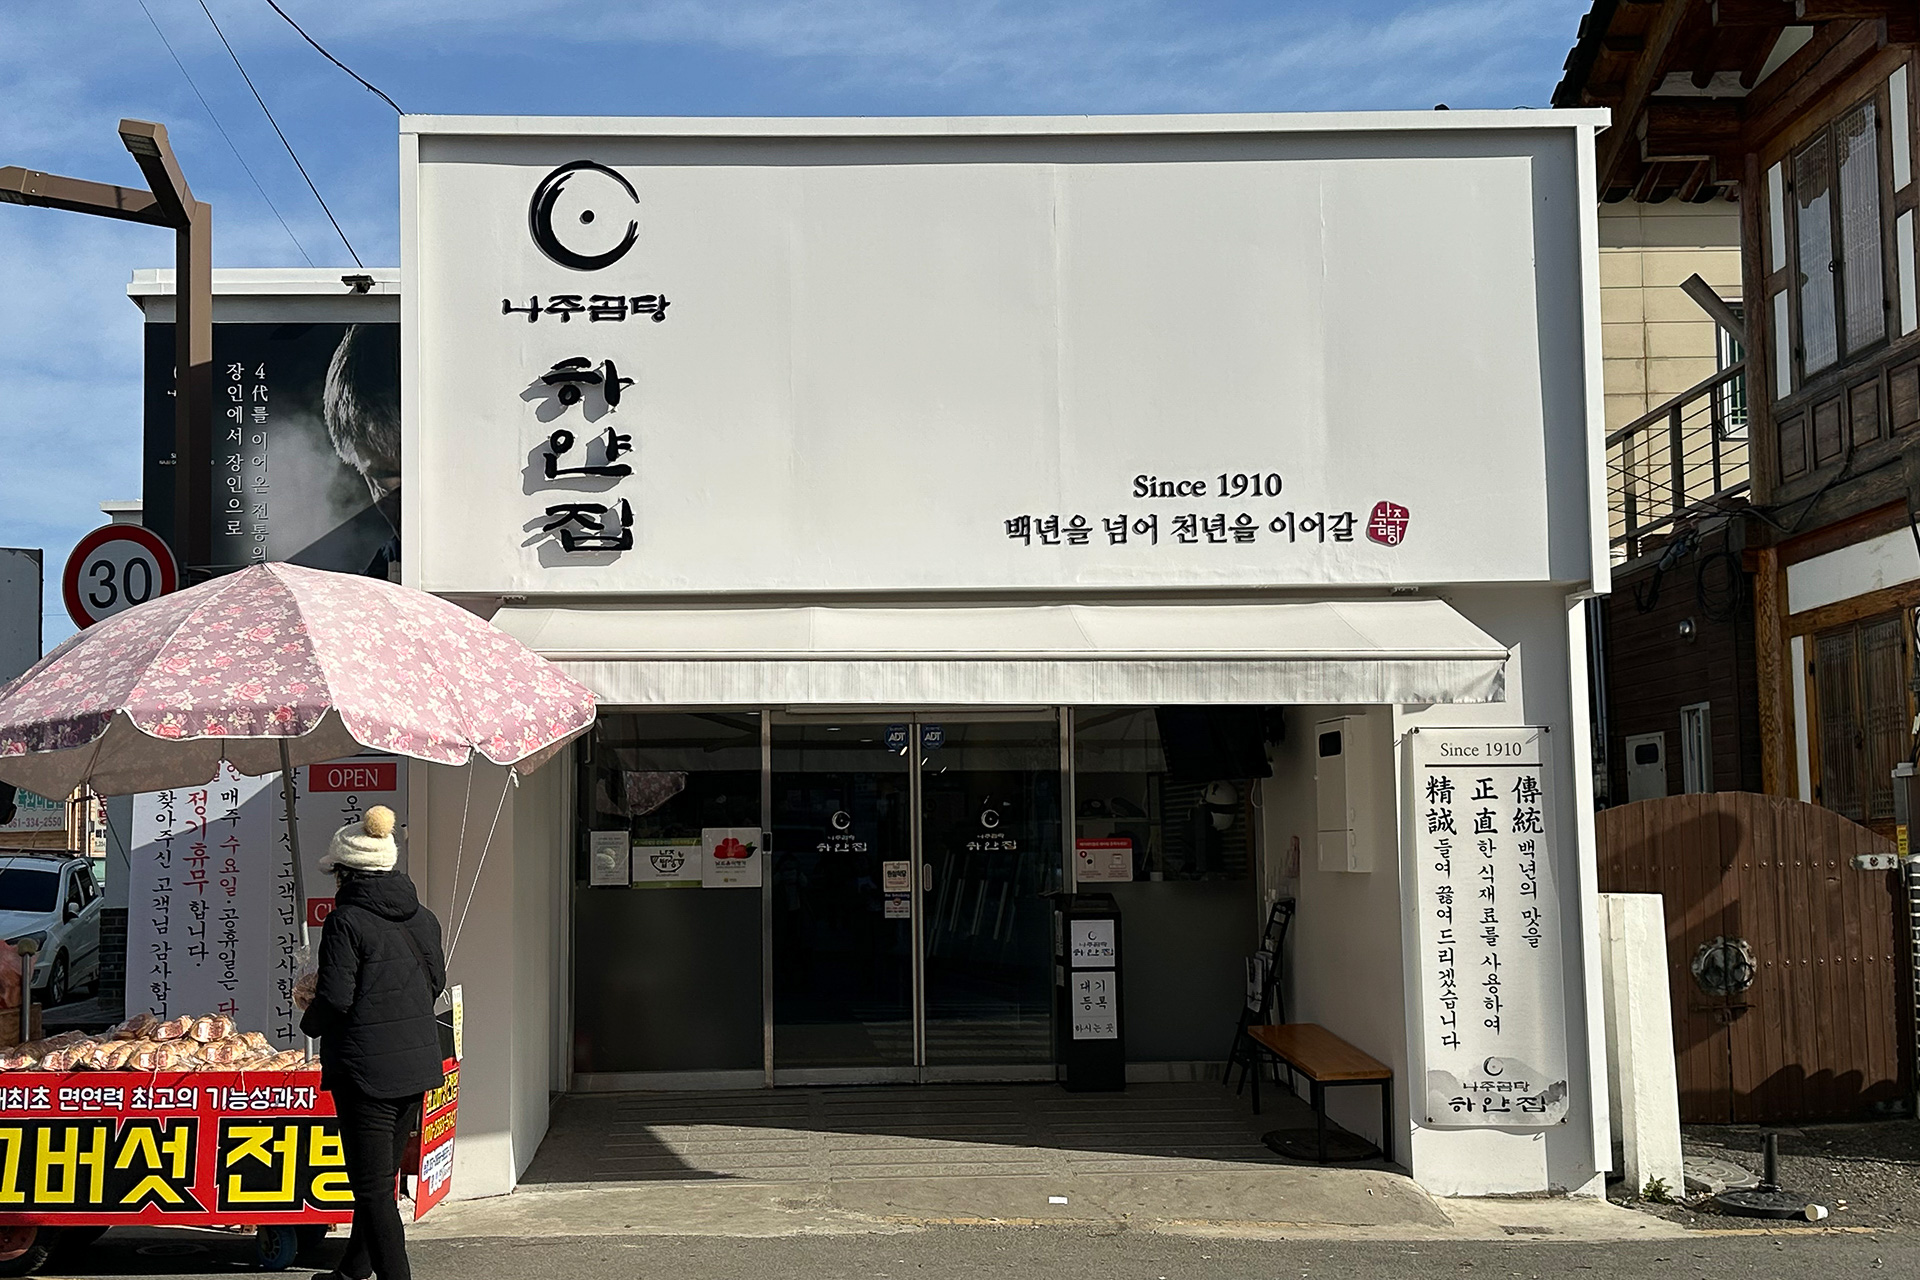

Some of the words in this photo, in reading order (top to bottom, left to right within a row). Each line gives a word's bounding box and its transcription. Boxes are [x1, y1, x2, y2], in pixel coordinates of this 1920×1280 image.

[501, 294, 671, 323] 나주곰탕
[226, 362, 245, 446] 장인에서
[251, 431, 270, 493] 이어온
[540, 356, 635, 552] 하얀집
[225, 454, 244, 536] 장인으로
[1132, 473, 1207, 499] Since
[1217, 472, 1283, 498] 1910
[1004, 514, 1093, 546] 백년을
[1101, 514, 1160, 546] 넘어
[1170, 513, 1260, 545] 천년을
[1268, 511, 1358, 545] 이어갈
[89, 557, 152, 609] 30
[888, 732, 906, 742] ADT
[924, 732, 942, 741] ADT
[1440, 742, 1480, 758] Since
[1486, 741, 1522, 757] 1910
[328, 768, 379, 788] OPEN
[221, 788, 241, 829] 매주
[154, 790, 177, 868] 찾아주신
[816, 842, 868, 852] 하얀집
[966, 840, 1017, 851] 하얀집
[152, 877, 173, 935] 고객님
[1476, 863, 1501, 947] 식재료를
[1521, 906, 1543, 949] 맛을
[149, 941, 173, 1020] 감사합니
[1434, 885, 1461, 1052] 끓여드리겠습니다
[1080, 979, 1106, 993] 대기
[1480, 952, 1503, 1036] 사용하여
[1080, 996, 1108, 1011] 등록
[1075, 1023, 1102, 1034] 하시는
[58, 1086, 124, 1111] 면연력
[130, 1086, 199, 1111] 최고의
[206, 1086, 318, 1111] 기능성과자
[1463, 1080, 1530, 1093] 나주곰탕
[1448, 1096, 1547, 1113] 하얀집
